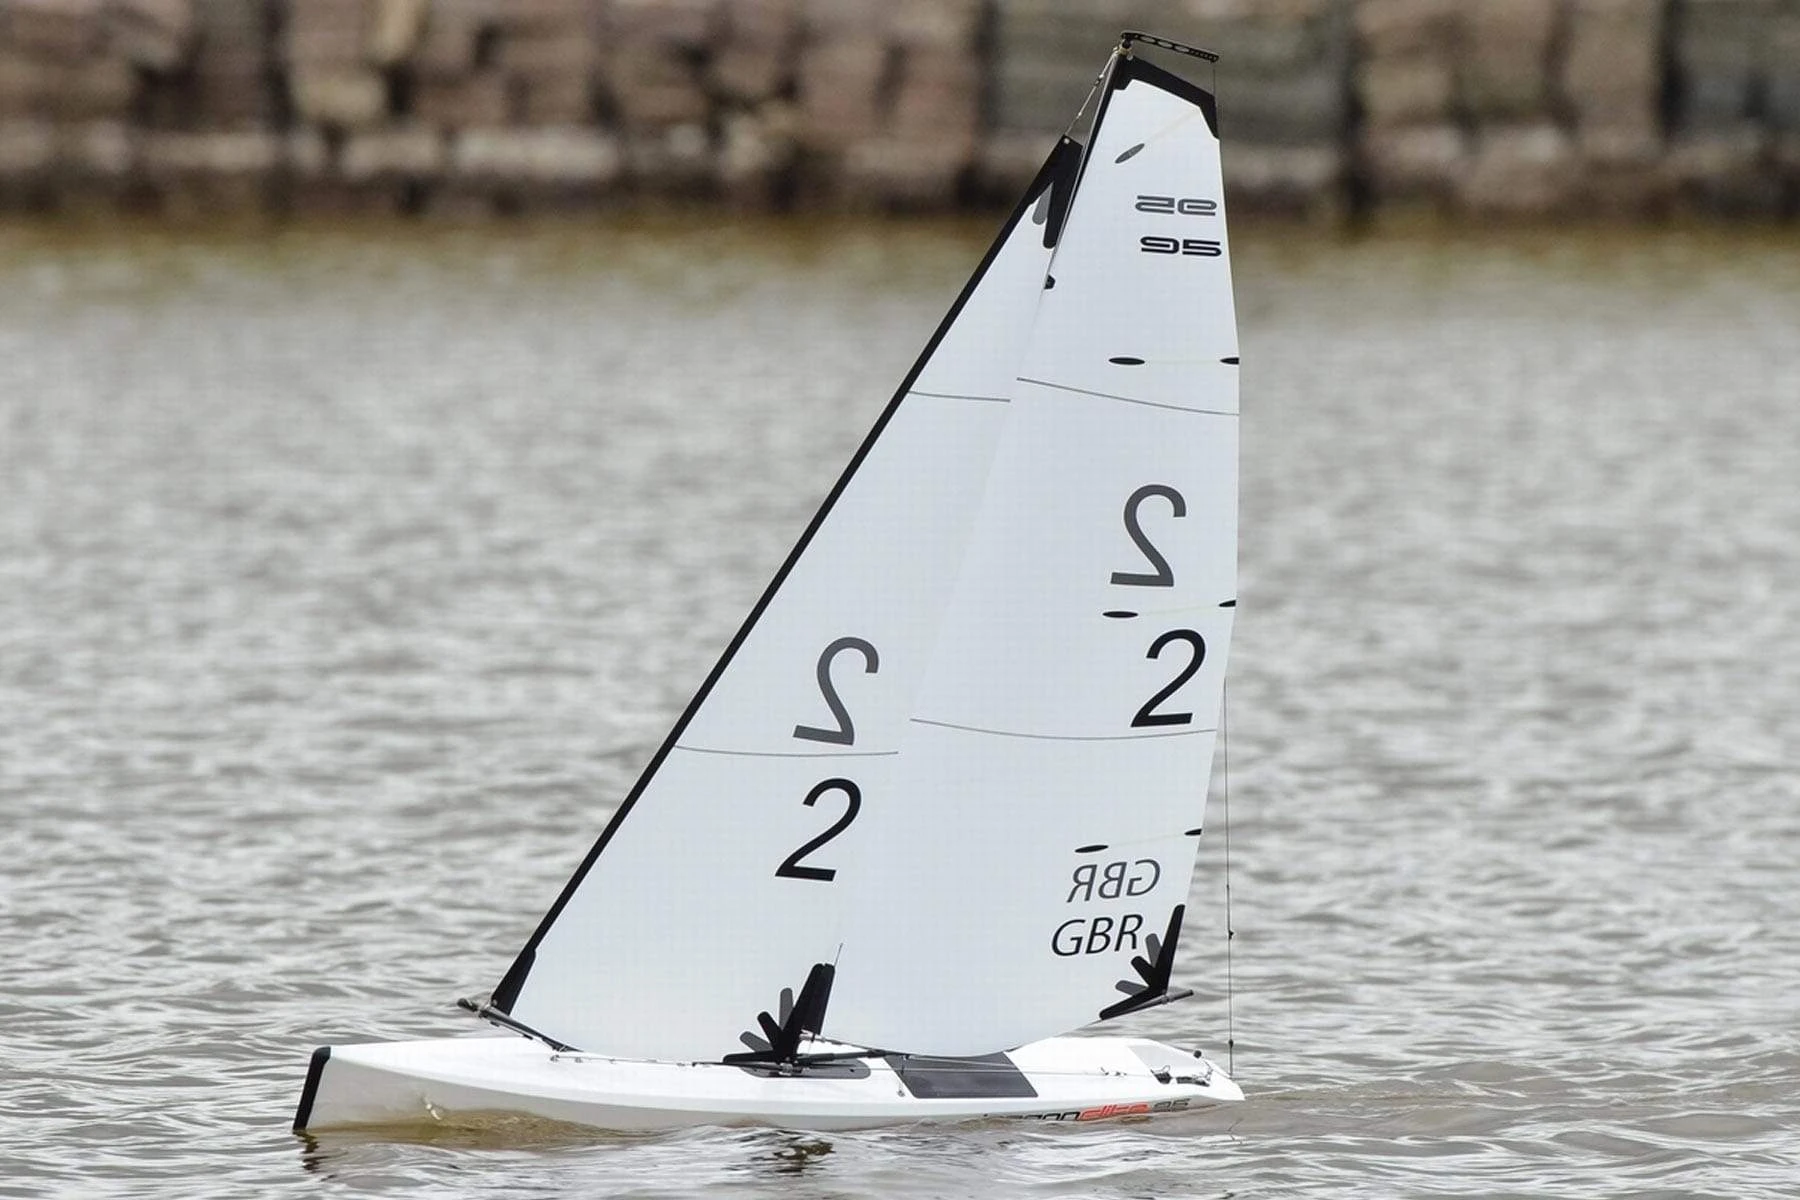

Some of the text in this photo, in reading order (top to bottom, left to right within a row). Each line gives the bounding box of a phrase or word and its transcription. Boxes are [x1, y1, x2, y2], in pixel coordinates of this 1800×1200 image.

[1140, 236, 1222, 257] 95
[1131, 629, 1206, 727] 2
[775, 778, 861, 881] 2
[1052, 914, 1143, 957] GBR
